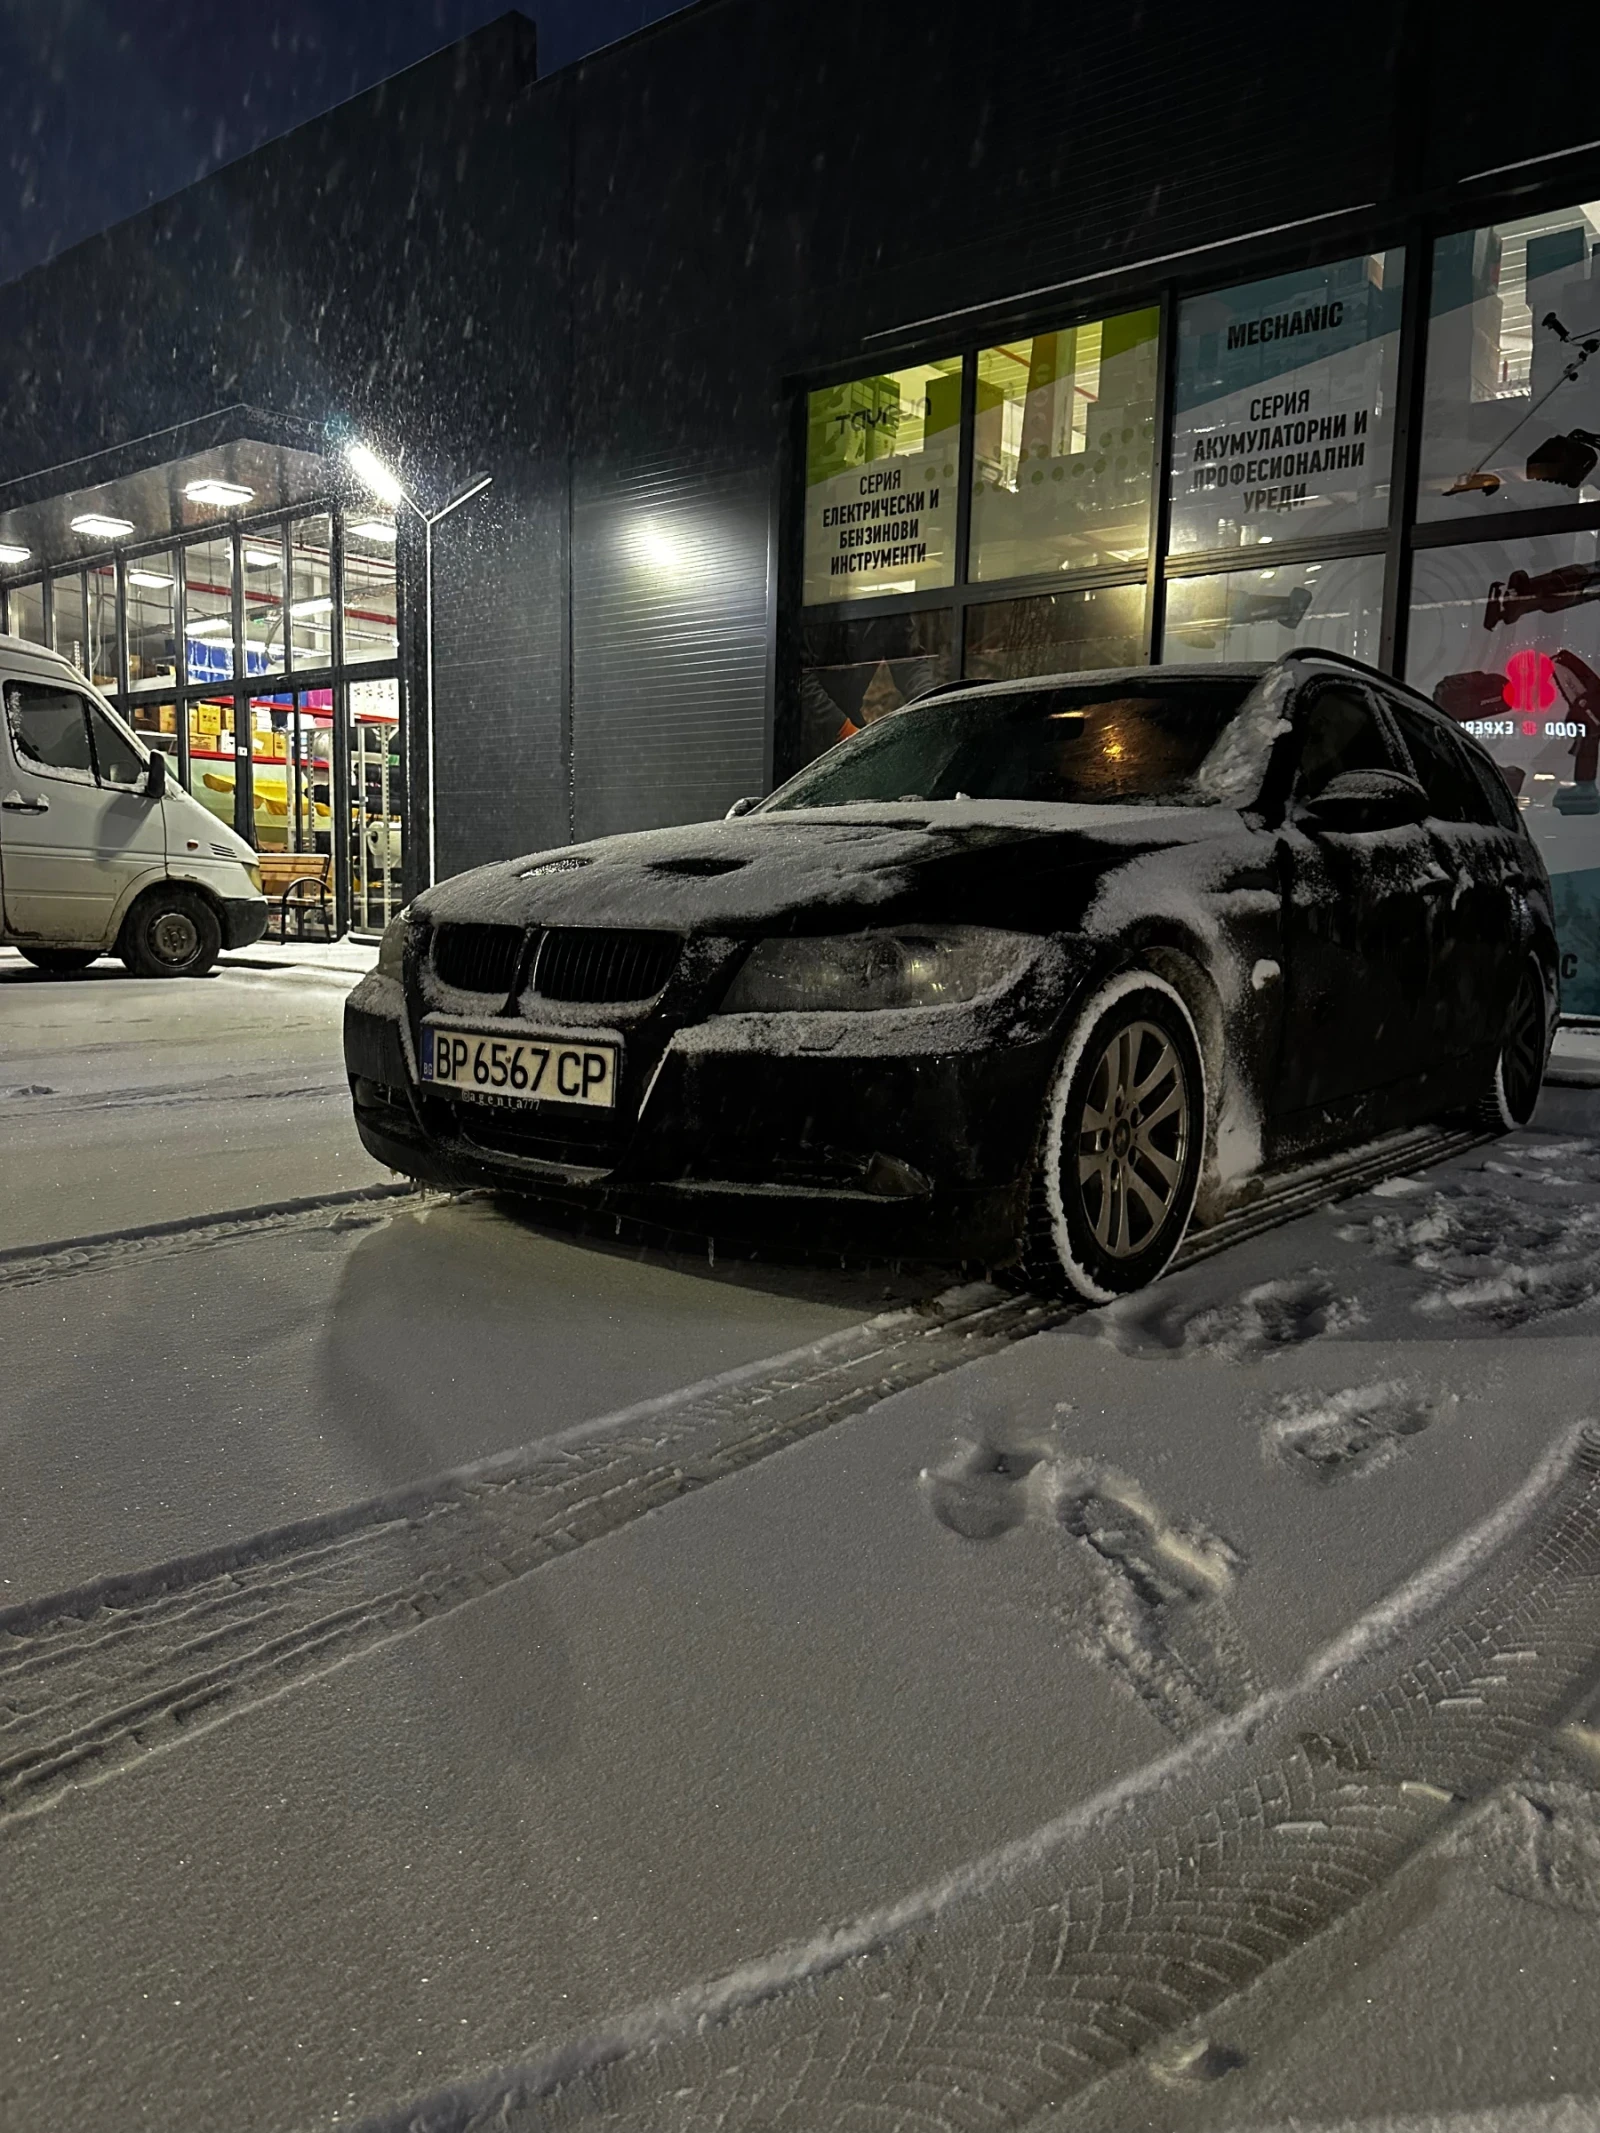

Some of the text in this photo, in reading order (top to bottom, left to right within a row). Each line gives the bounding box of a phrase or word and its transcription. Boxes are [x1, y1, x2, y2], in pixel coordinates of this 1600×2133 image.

[1227, 302, 1344, 350] MECHANIC
[1250, 390, 1310, 421] СЕРИЯ
[1193, 410, 1368, 462] АКУМУЛАТОРНИ И
[1193, 443, 1365, 487] ПРОФЕСИОНАЛНИ
[860, 469, 901, 495] СЕРИЯ
[822, 488, 939, 527] ЕЛЕКТРИЧЕСКИ И
[1243, 483, 1307, 513] УРЕДИ
[839, 519, 919, 549] БЕНЗИНОВИ
[830, 543, 926, 575] ИНСТРУМЕНТИ
[423, 1062, 433, 1076] BG
